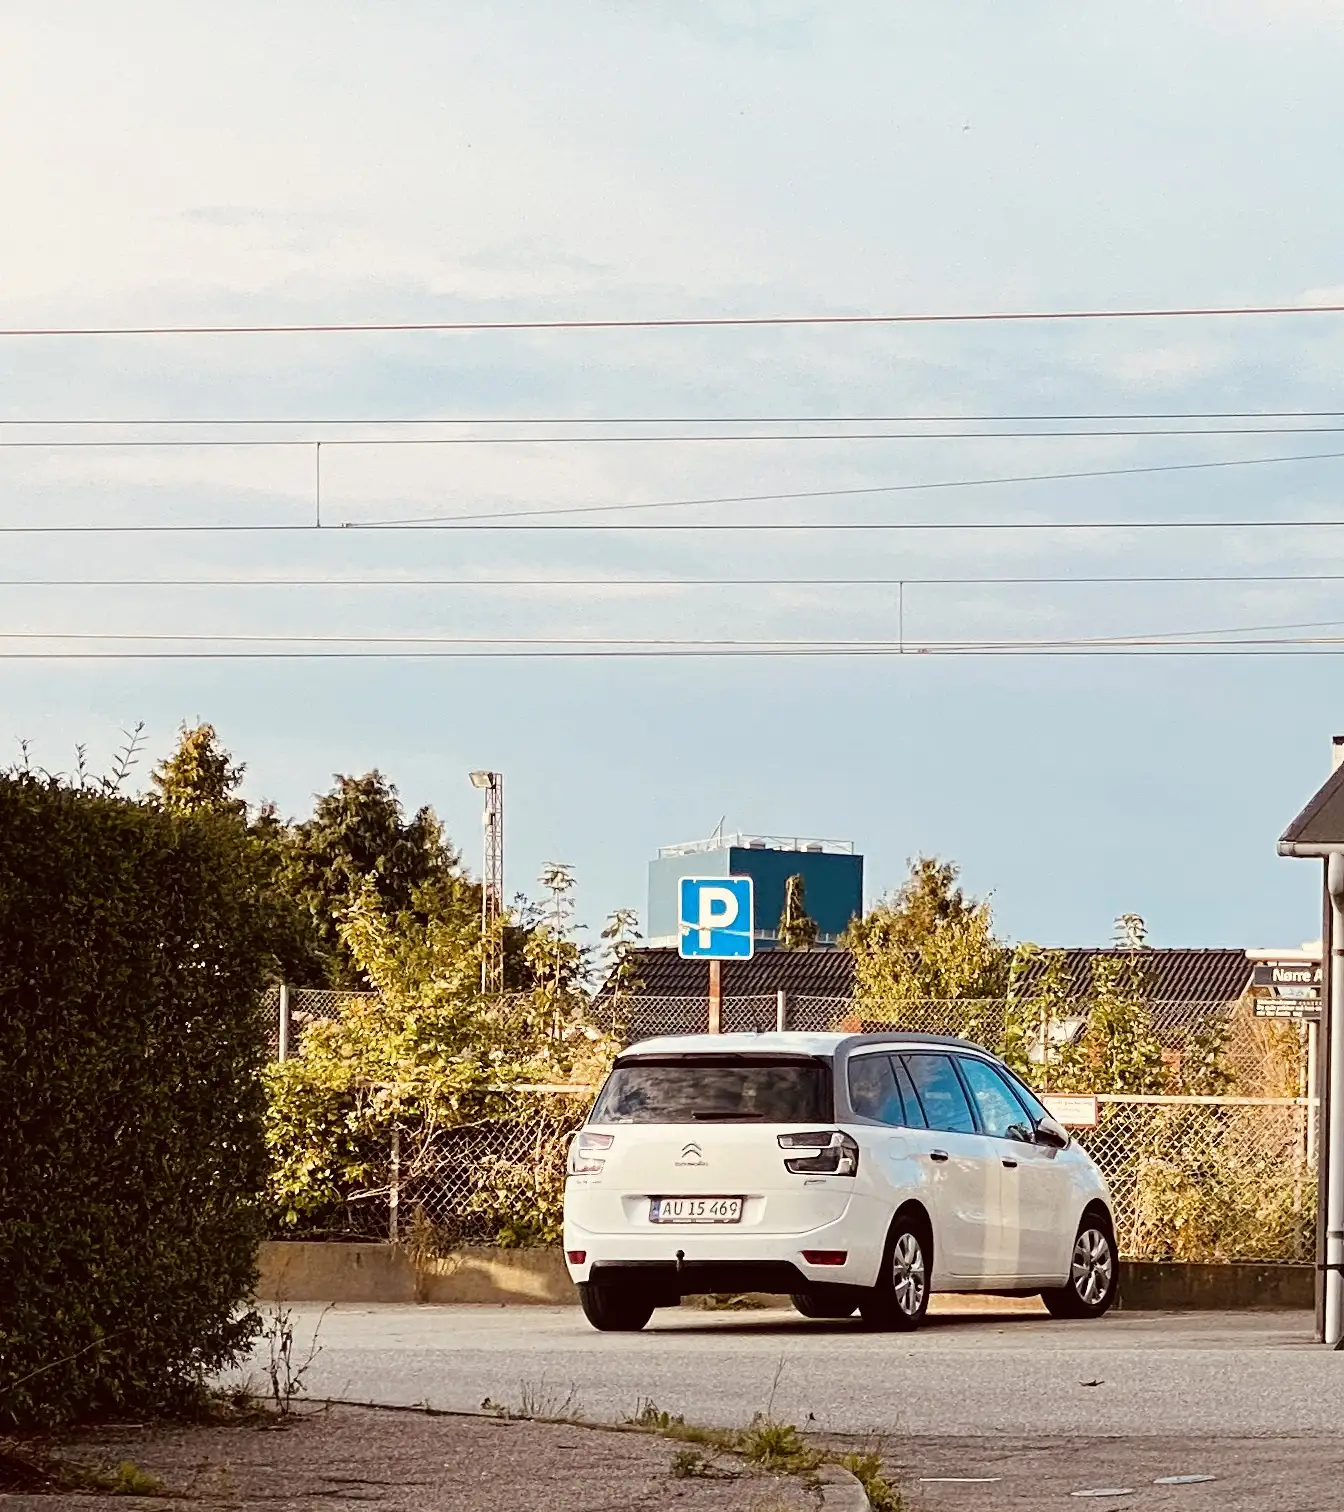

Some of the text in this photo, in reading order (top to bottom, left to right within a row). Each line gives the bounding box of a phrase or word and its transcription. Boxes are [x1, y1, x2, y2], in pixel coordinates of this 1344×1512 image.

[698, 887, 739, 949] P
[1273, 969, 1311, 982] Nørre
[662, 1201, 738, 1216] AU 15 469
